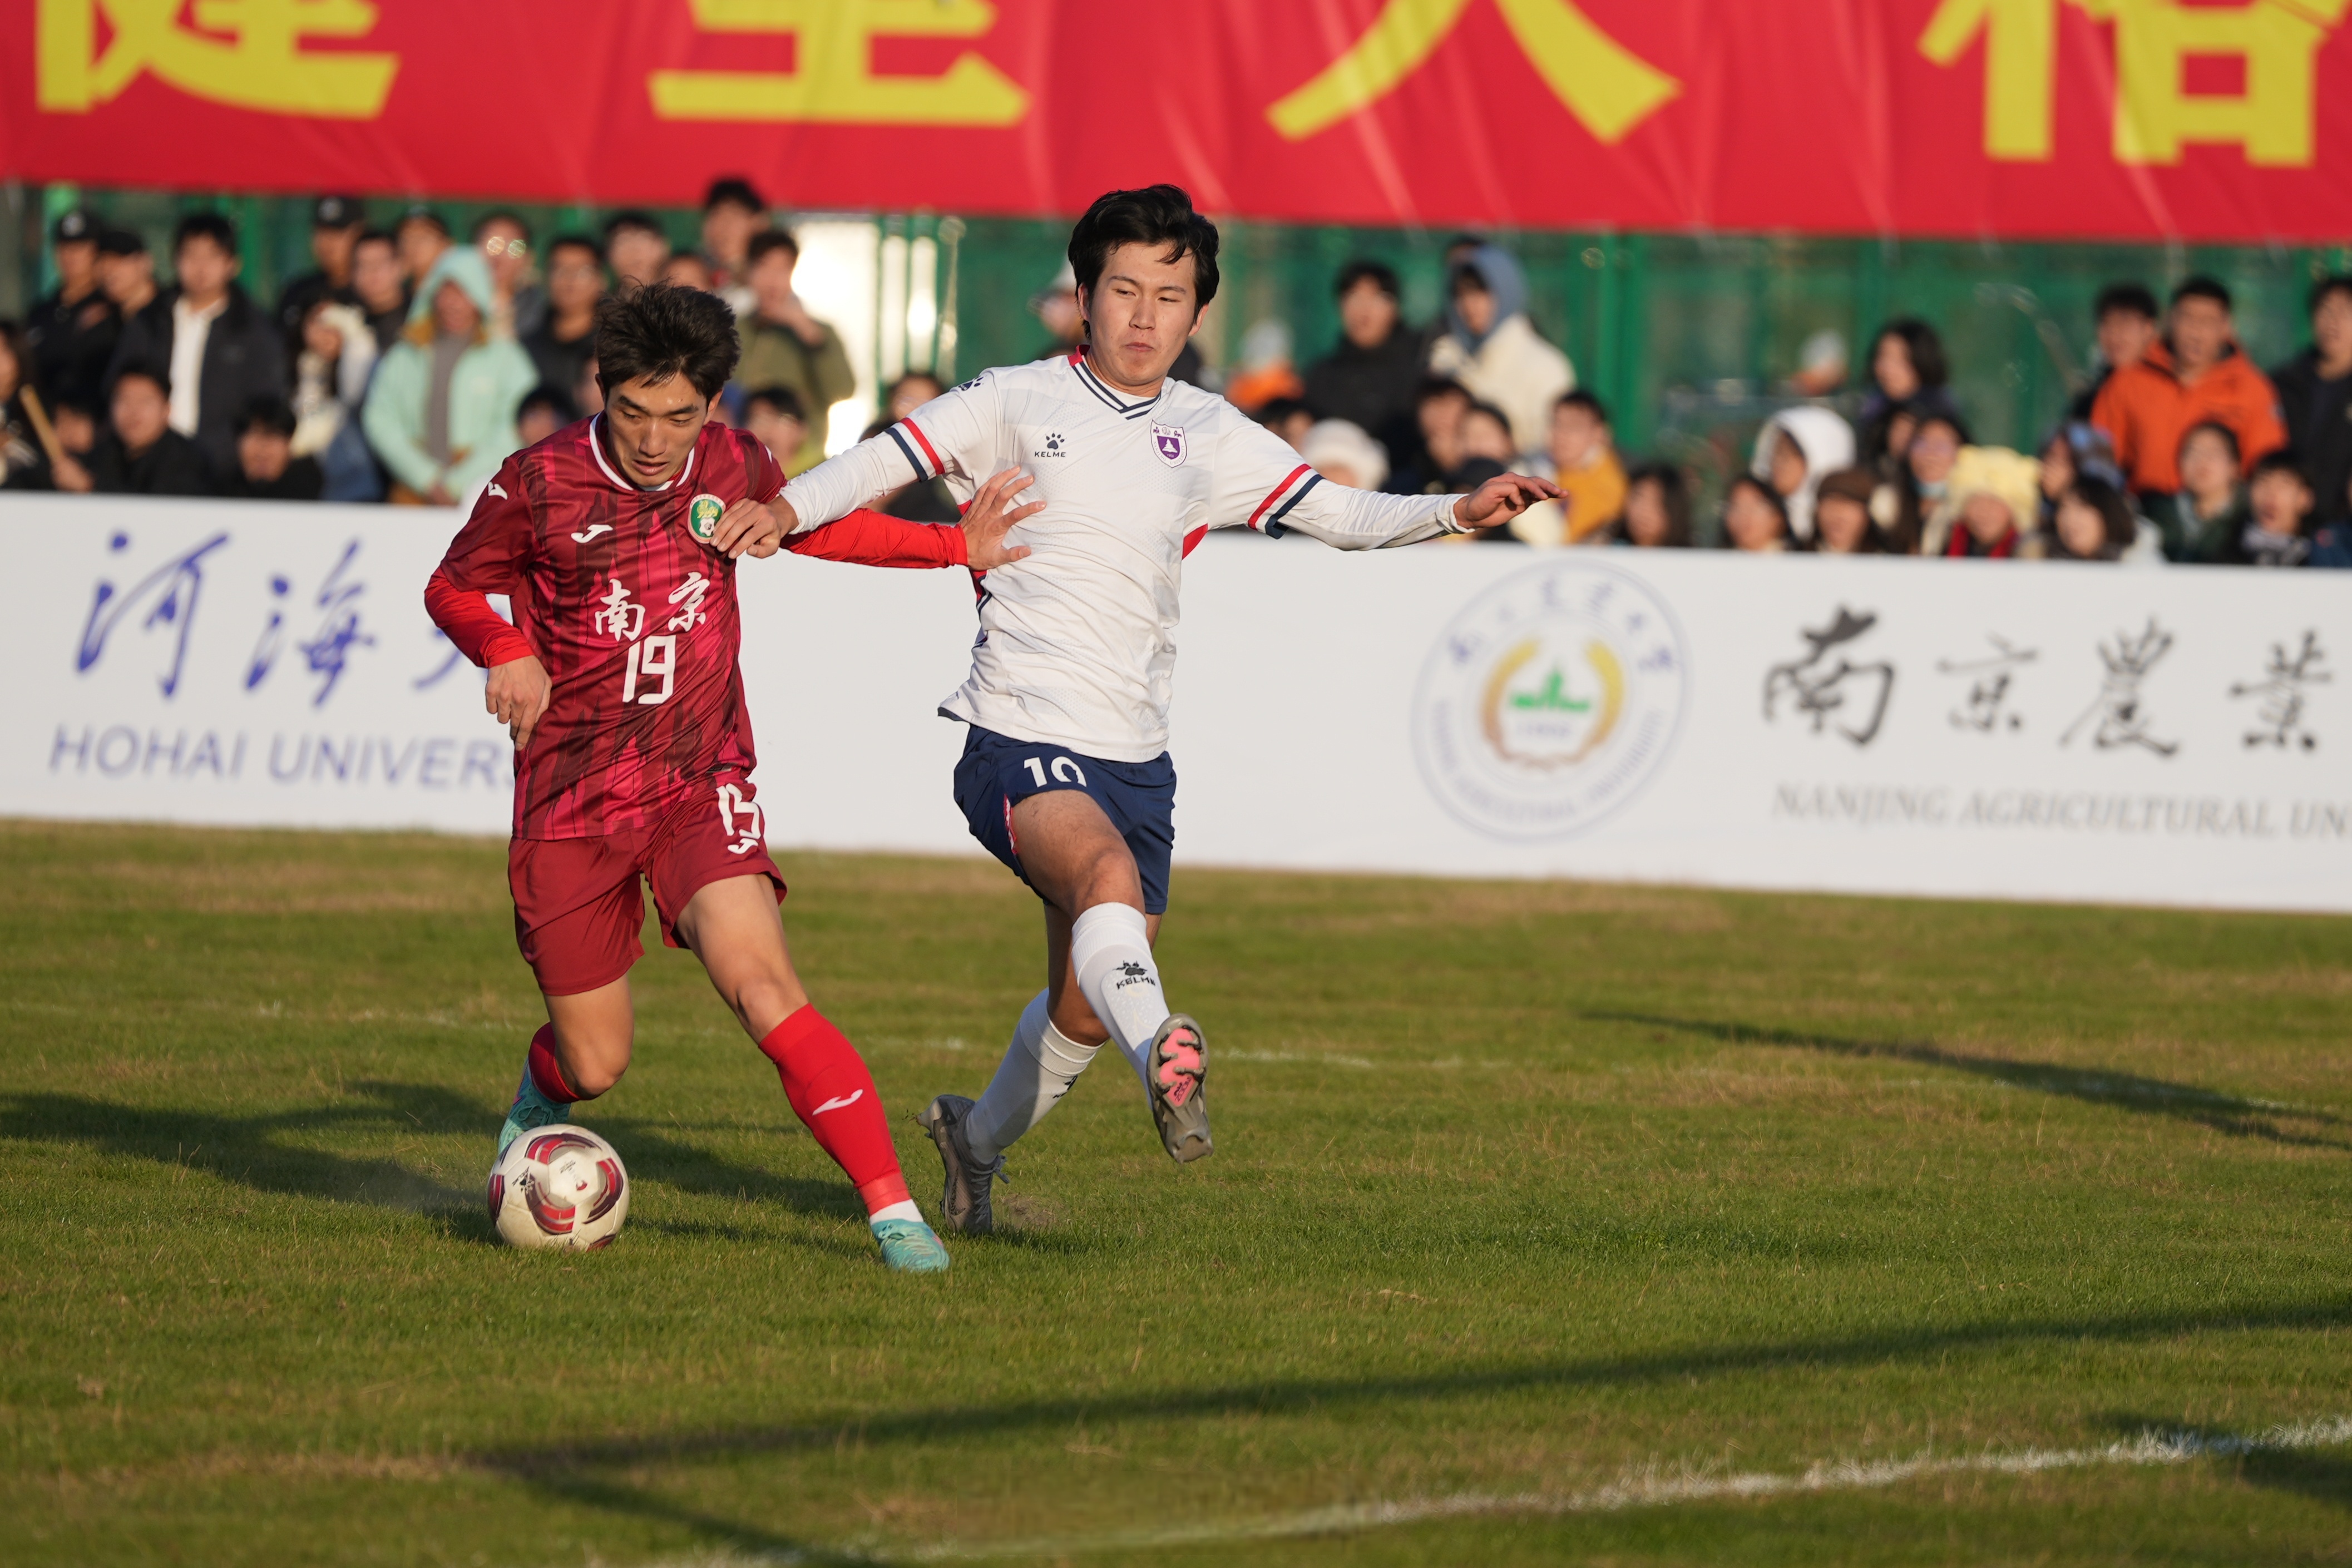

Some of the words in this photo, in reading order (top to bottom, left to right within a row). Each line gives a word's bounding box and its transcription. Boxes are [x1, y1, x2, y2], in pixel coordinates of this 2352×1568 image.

[75, 530, 505, 709] 河海
[595, 571, 710, 642] 南京
[622, 635, 676, 705] 19
[49, 724, 248, 779] HOHAI
[267, 729, 515, 789] UNIVER
[1771, 780, 1951, 830] NANJING
[1957, 787, 2274, 839] AGRICULTURAL
[2287, 798, 2352, 840] UN
